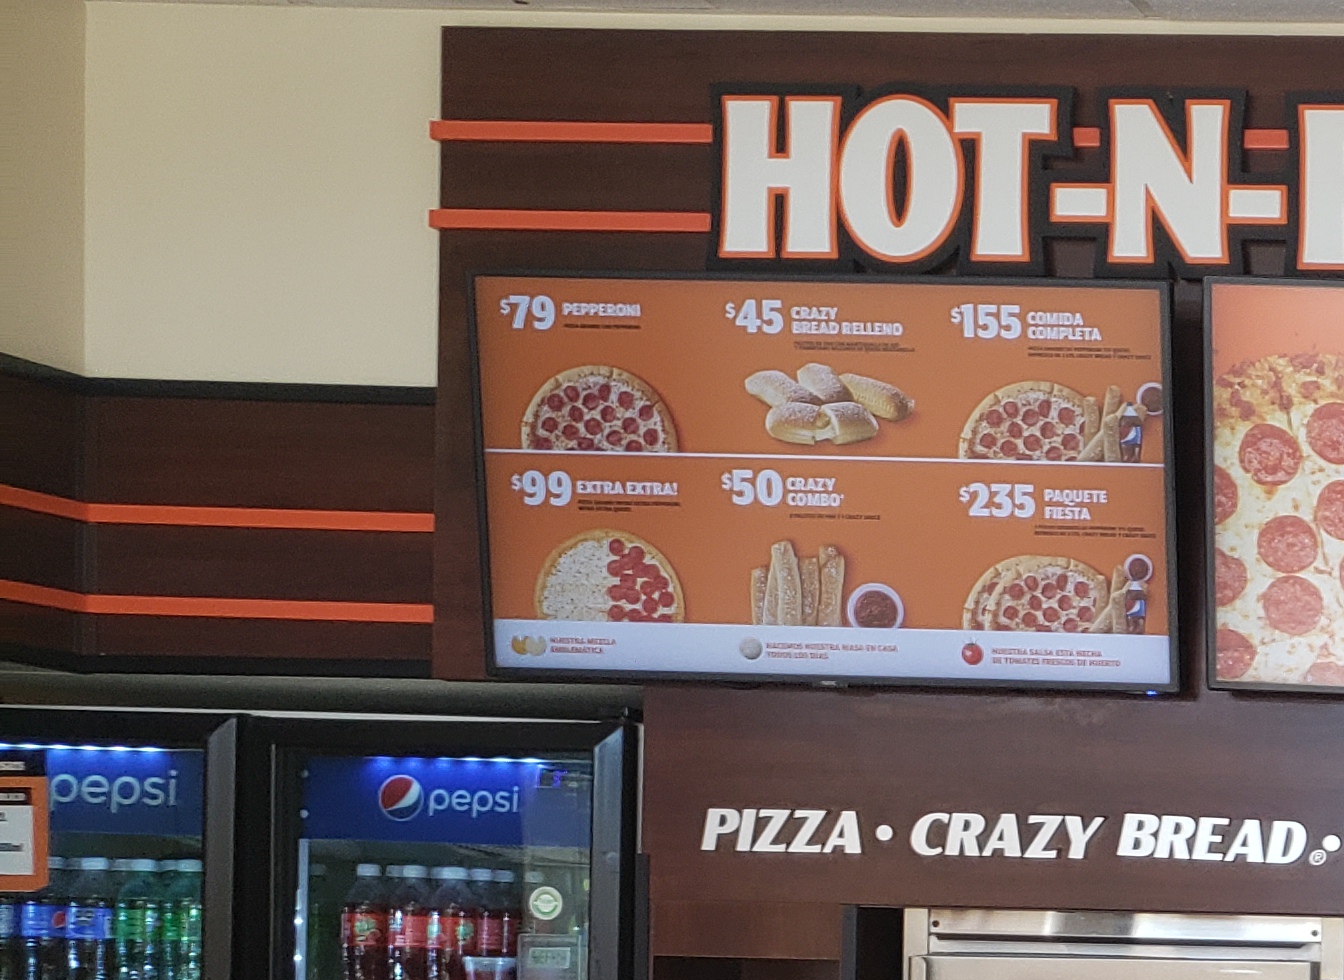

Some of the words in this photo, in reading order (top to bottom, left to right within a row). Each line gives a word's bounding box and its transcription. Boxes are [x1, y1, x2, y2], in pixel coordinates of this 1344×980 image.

[500, 294, 556, 330] $79
[562, 302, 641, 317] PEPPERONI
[725, 299, 784, 335] $45
[790, 306, 838, 320] CRAZY
[1026, 311, 1084, 326] COMIDA
[791, 320, 840, 335] BREAD
[841, 321, 904, 336] RELLENO
[950, 303, 1022, 340] $155
[1026, 326, 1103, 341] COMPLETA
[510, 470, 573, 506] $99
[576, 480, 624, 495] EXTRA
[625, 481, 678, 496] EXTRA!
[721, 469, 784, 506] $50
[785, 477, 836, 491] CRAZY
[959, 482, 1036, 518] $235
[1043, 489, 1108, 505] PAQUETE
[1044, 506, 1091, 520] FIESTA
[50, 770, 178, 814] pepsi
[428, 786, 520, 817] pepsi
[701, 808, 863, 854] PIZZA
[909, 812, 1110, 860] CRAZY
[1115, 815, 1308, 866] BREAD
